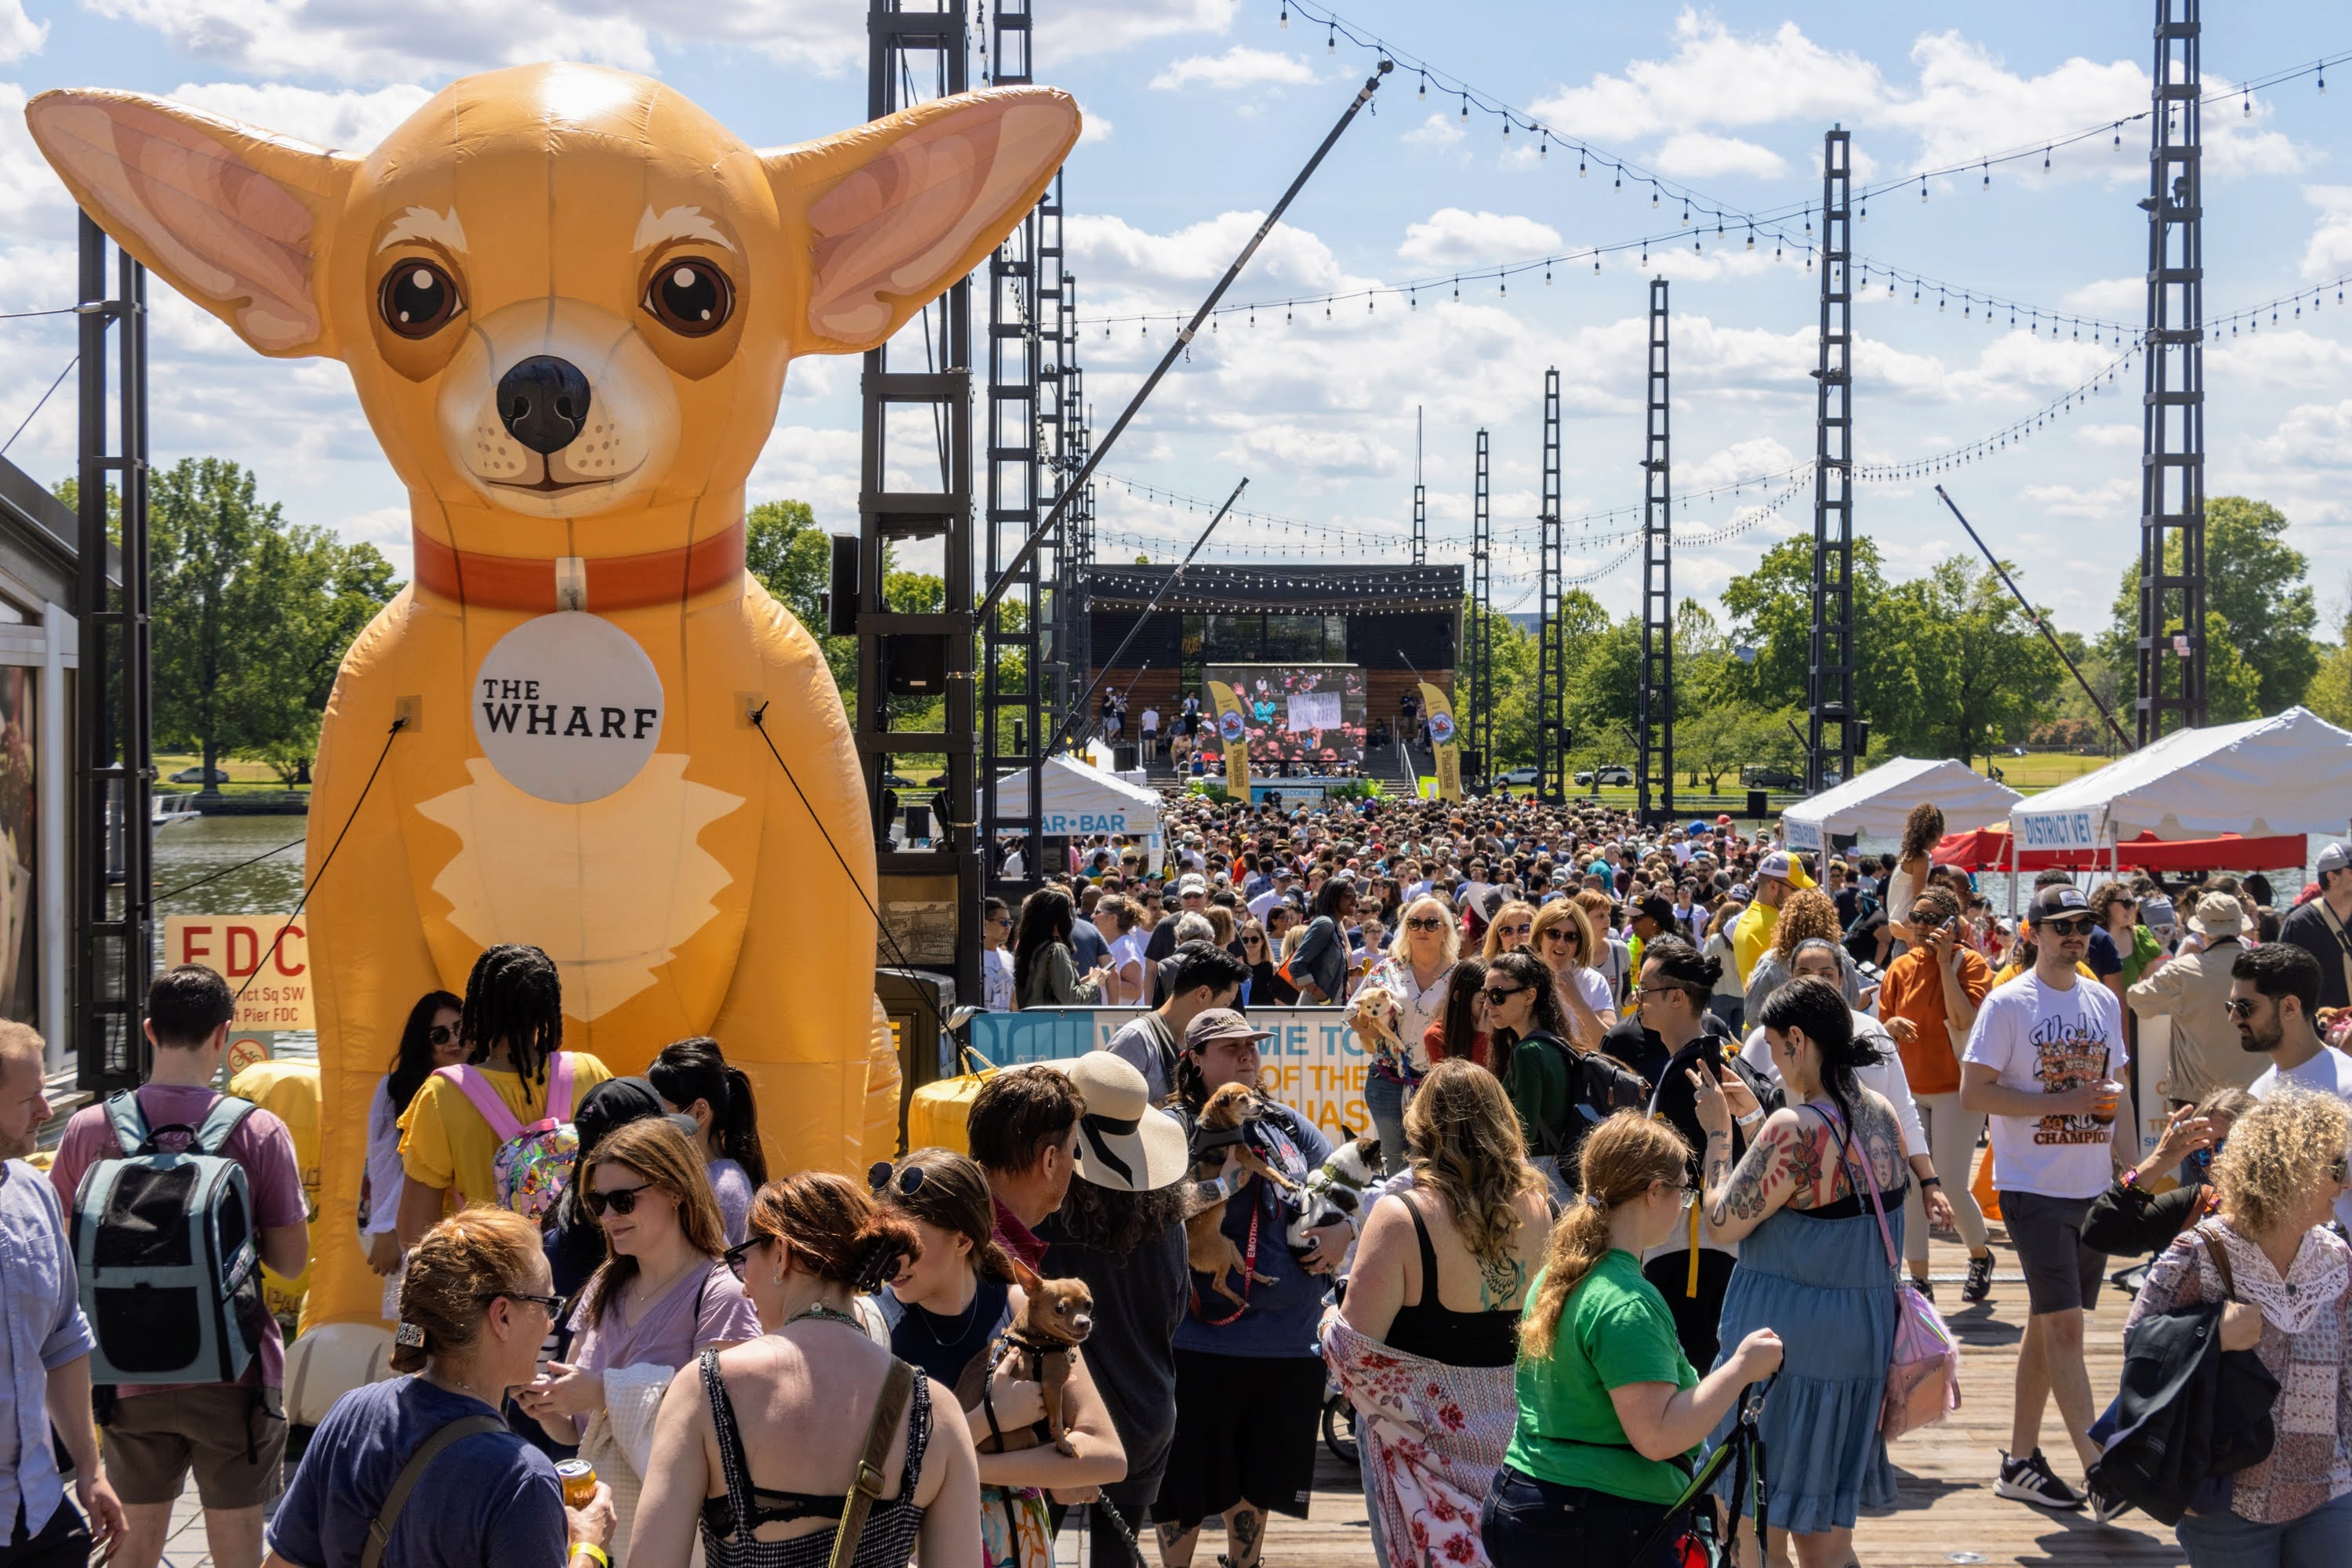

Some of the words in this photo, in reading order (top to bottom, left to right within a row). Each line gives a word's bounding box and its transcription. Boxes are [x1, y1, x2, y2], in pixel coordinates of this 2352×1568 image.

[483, 679, 539, 700] THE
[482, 702, 657, 739] WHARF
[2024, 816, 2069, 845] DISTRICT
[2072, 813, 2093, 844] VET
[263, 987, 279, 1004] Sq
[282, 986, 306, 1000] SW
[244, 1007, 270, 1022] Pier
[273, 1007, 299, 1022] FDC
[1308, 1065, 1368, 1091] THE
